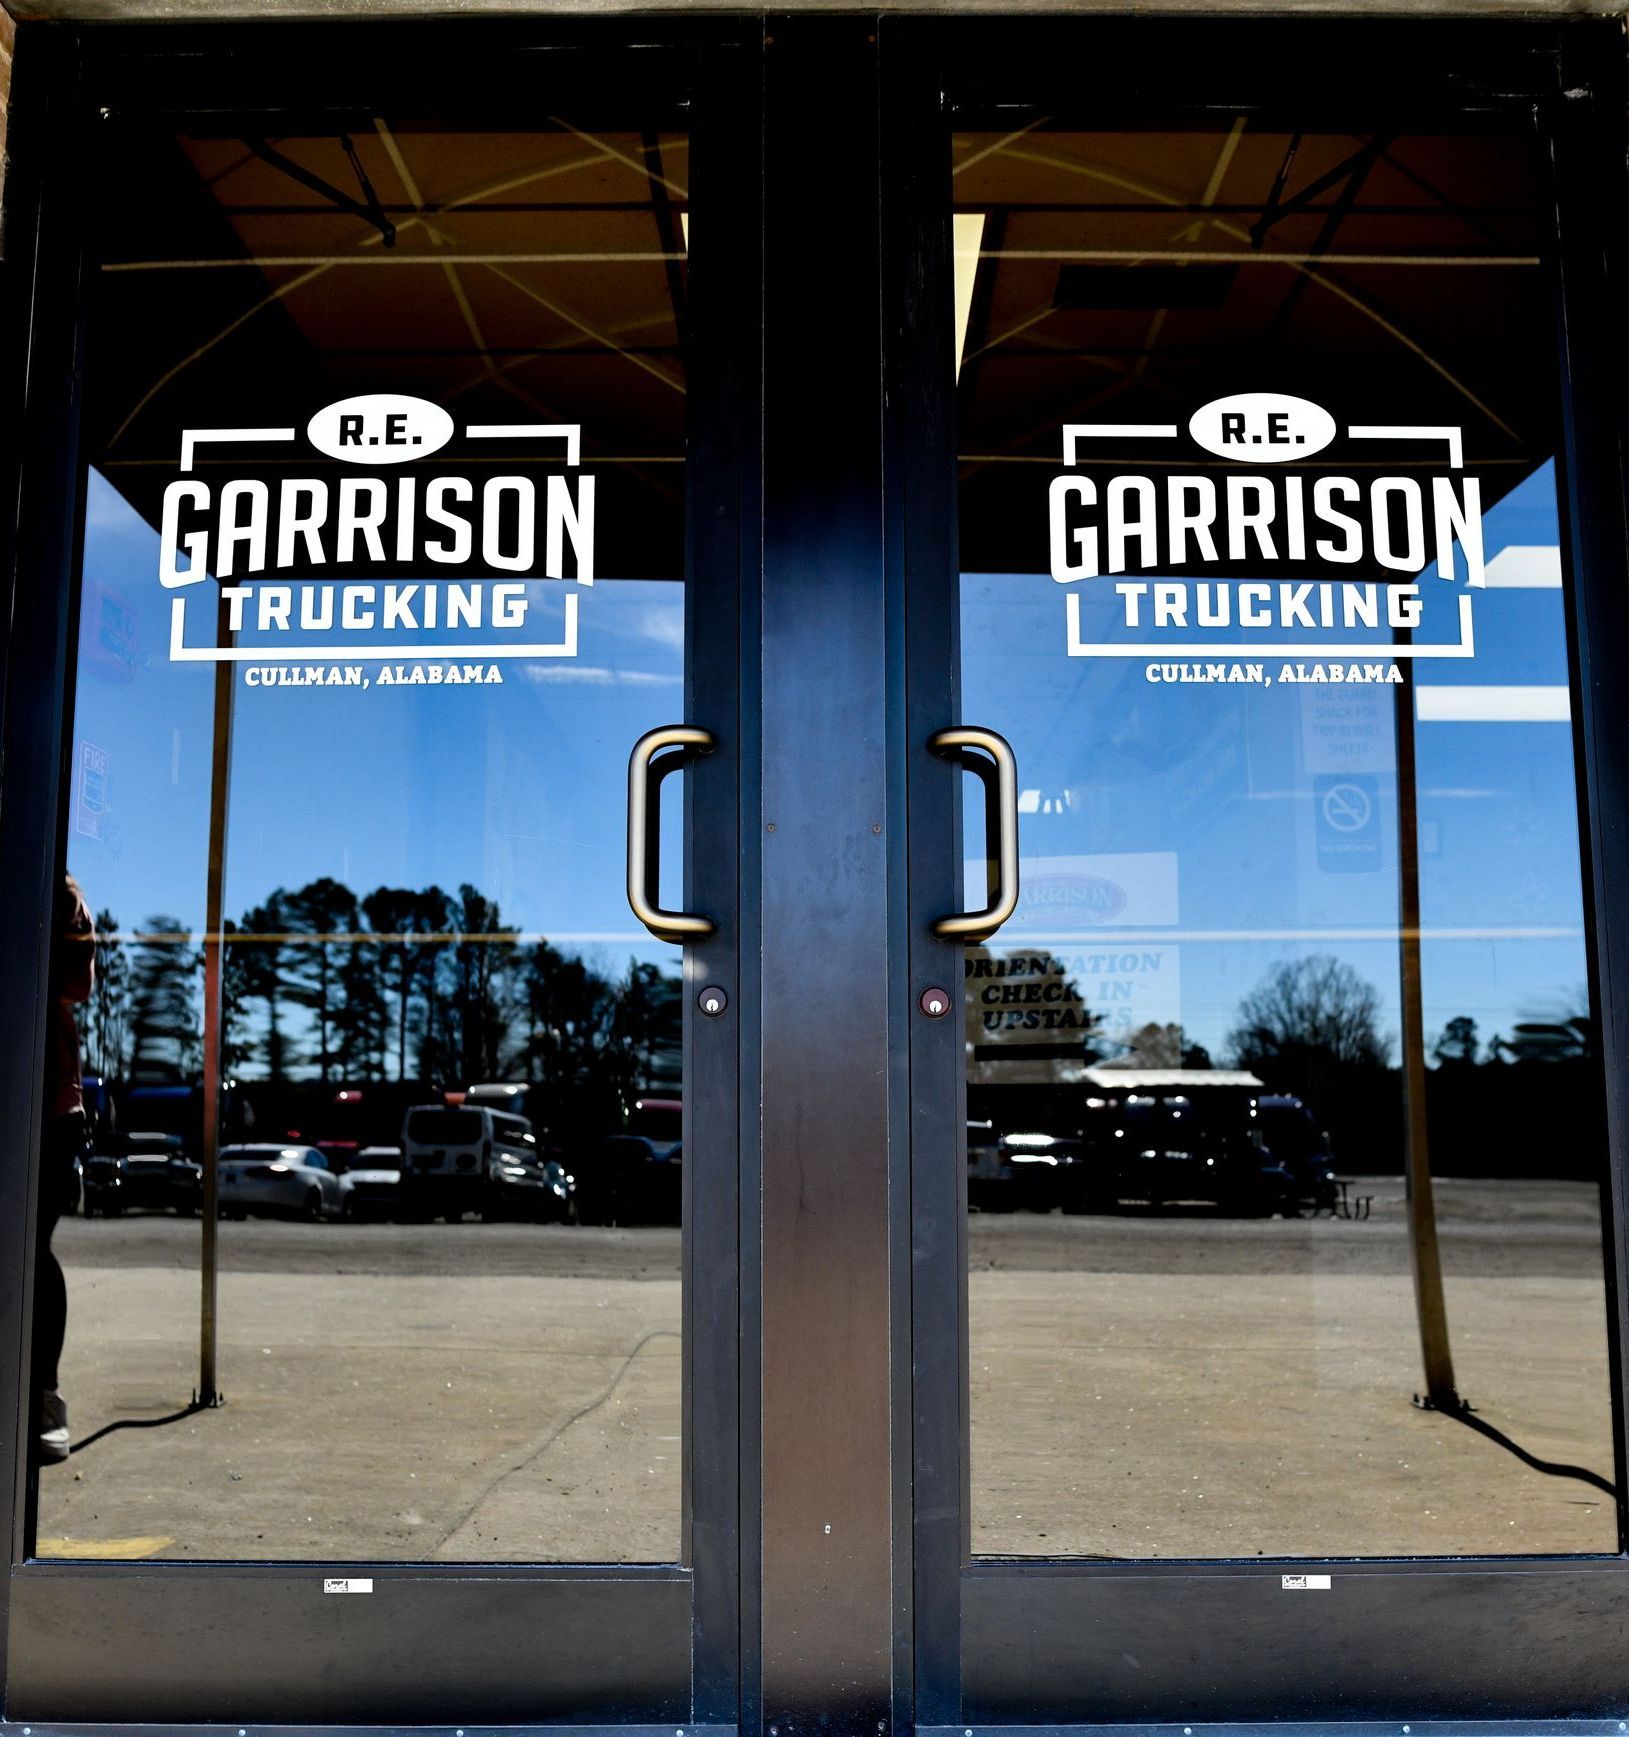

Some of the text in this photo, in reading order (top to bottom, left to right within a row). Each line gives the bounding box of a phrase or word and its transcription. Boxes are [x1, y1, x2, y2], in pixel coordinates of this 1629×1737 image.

[338, 413, 422, 446] R.E.
[1221, 412, 1305, 444] R.E.
[159, 474, 595, 588] GARRISON
[1049, 475, 1486, 588] GARRISON
[221, 583, 529, 631] TRUCKING
[1115, 583, 1423, 628] TRUCKING
[244, 665, 503, 689] CULLMAN, ALABAMA
[1145, 664, 1404, 687] CULLMAN, ALABAMA
[1020, 885, 1112, 908] ARRISON
[981, 980, 1134, 1004] CHECK IN
